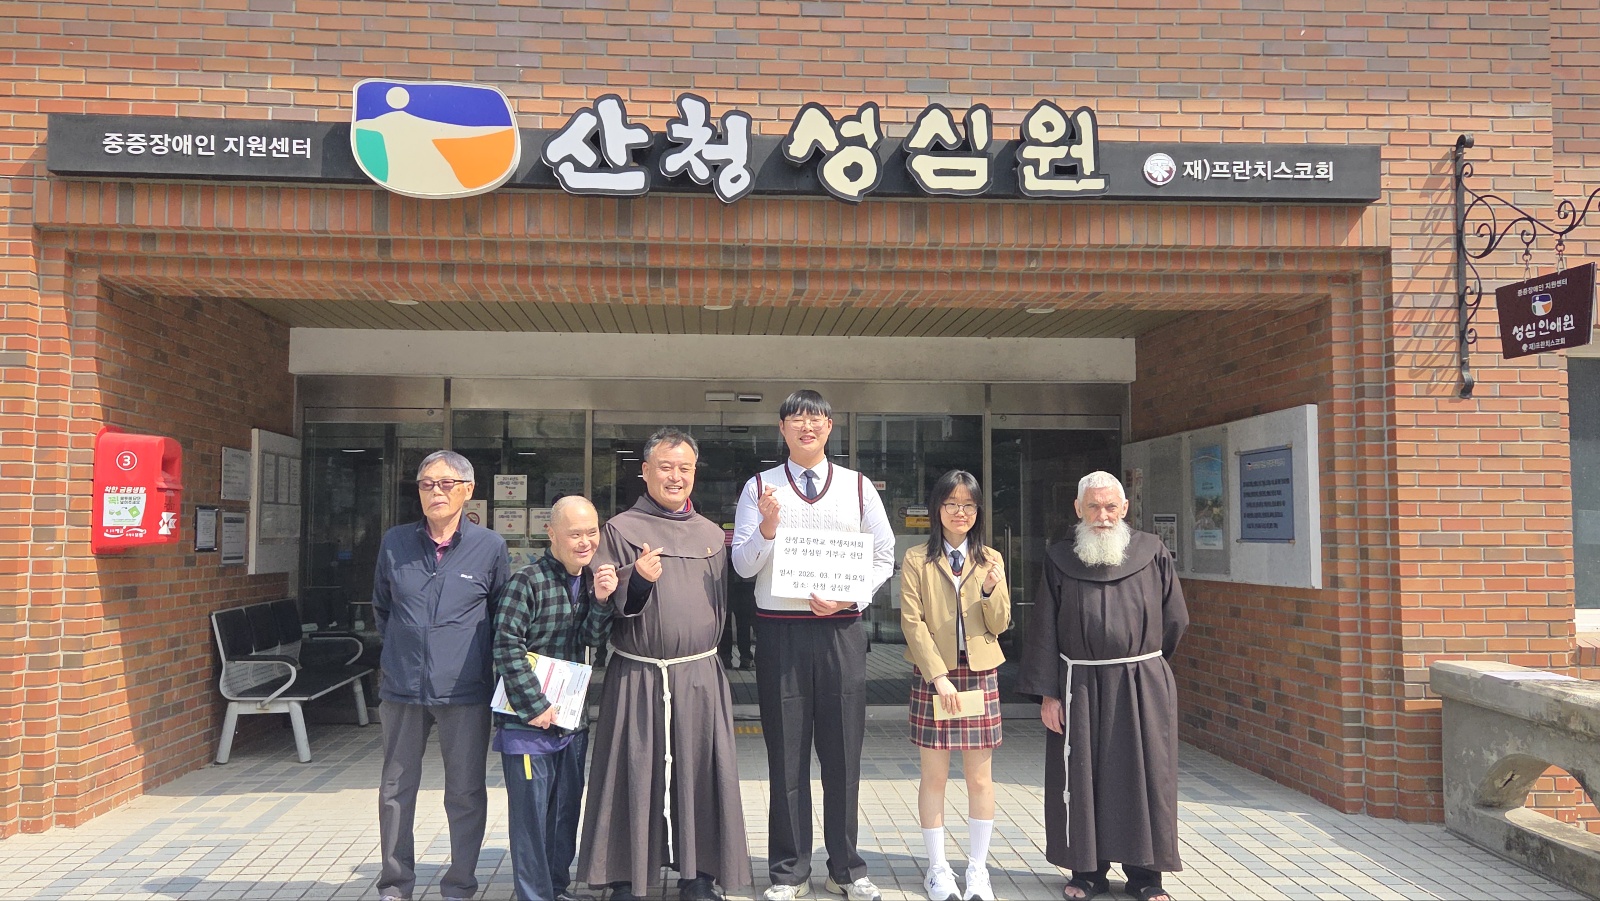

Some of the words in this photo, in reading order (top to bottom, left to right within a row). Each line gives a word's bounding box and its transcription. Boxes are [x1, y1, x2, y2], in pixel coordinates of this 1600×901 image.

[102, 132, 215, 155] 중증장애인
[223, 136, 312, 159] 지원센터
[541, 94, 756, 203] 산청
[783, 99, 1110, 203] 성심원
[1182, 158, 1335, 182] 재)프란치스코회
[1517, 283, 1544, 297] 중증장애인
[1545, 278, 1568, 289] 지원센터
[122, 455, 131, 466] 3
